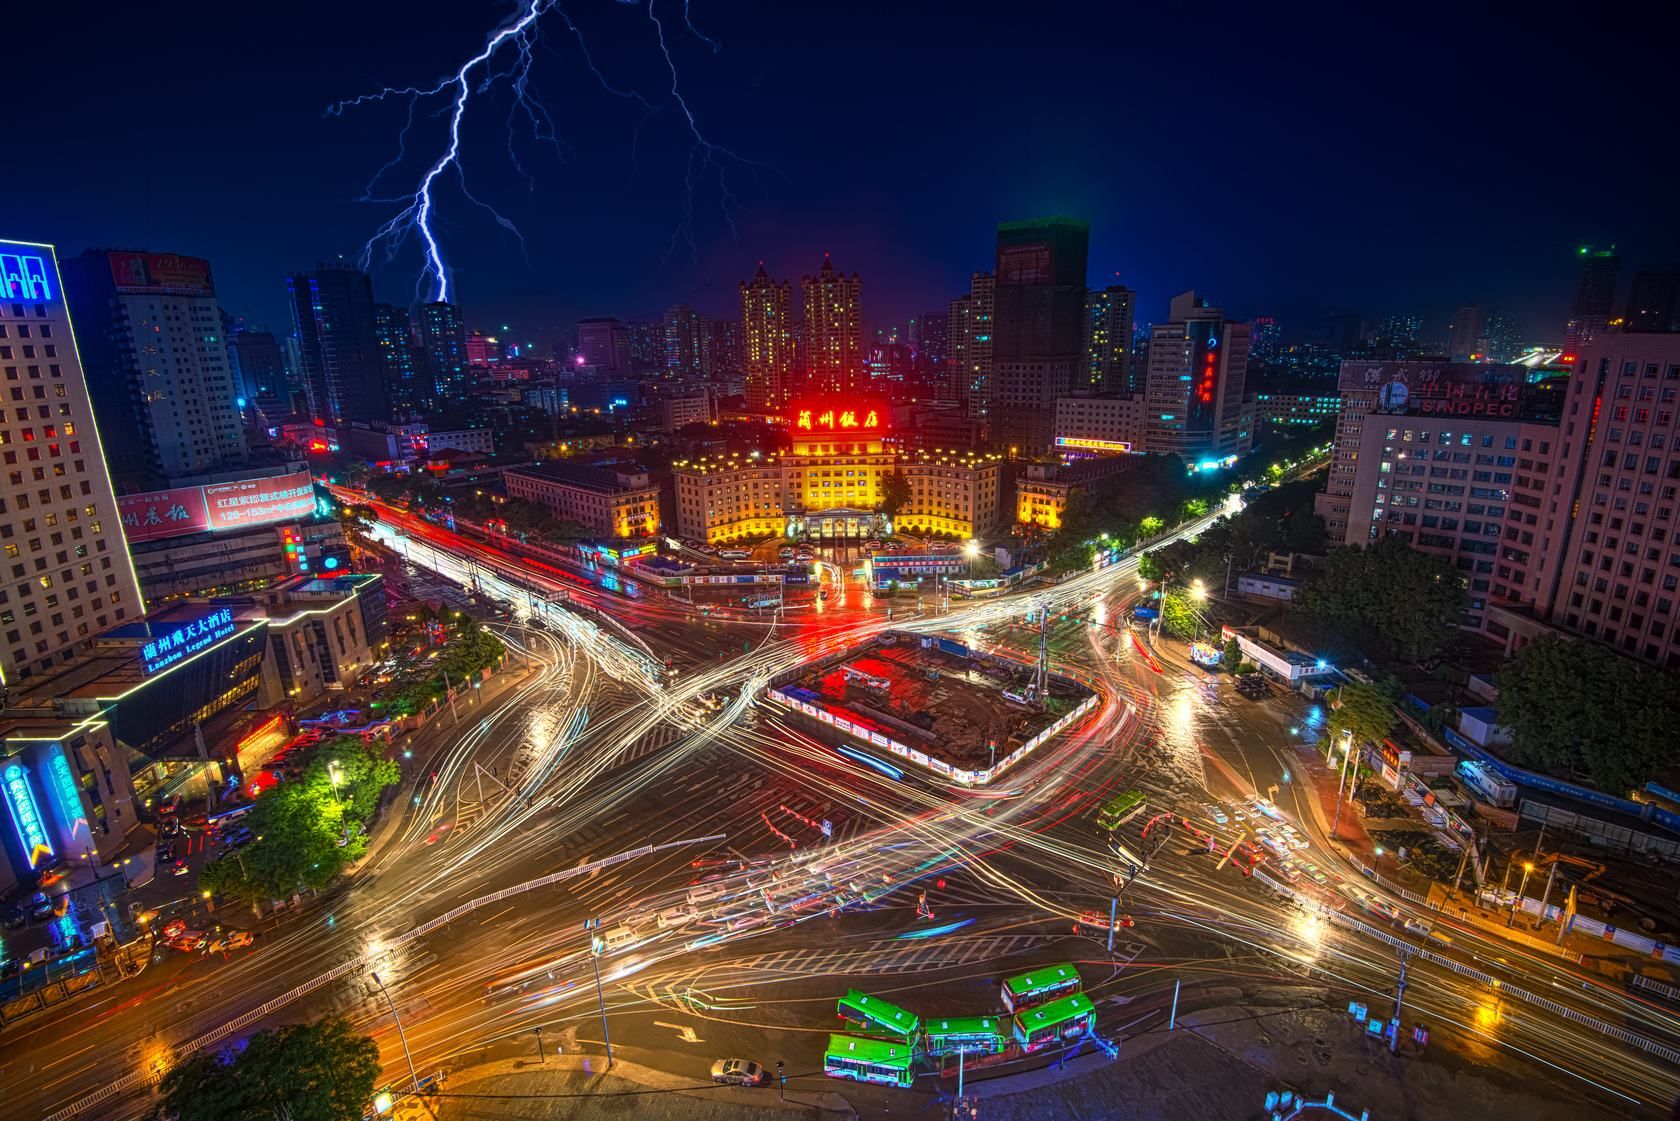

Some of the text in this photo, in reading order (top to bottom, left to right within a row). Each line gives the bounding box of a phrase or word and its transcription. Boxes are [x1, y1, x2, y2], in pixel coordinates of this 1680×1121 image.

[1422, 399, 1513, 415] SINOPEC
[148, 624, 235, 673] Lanzhou Legend Hotel
